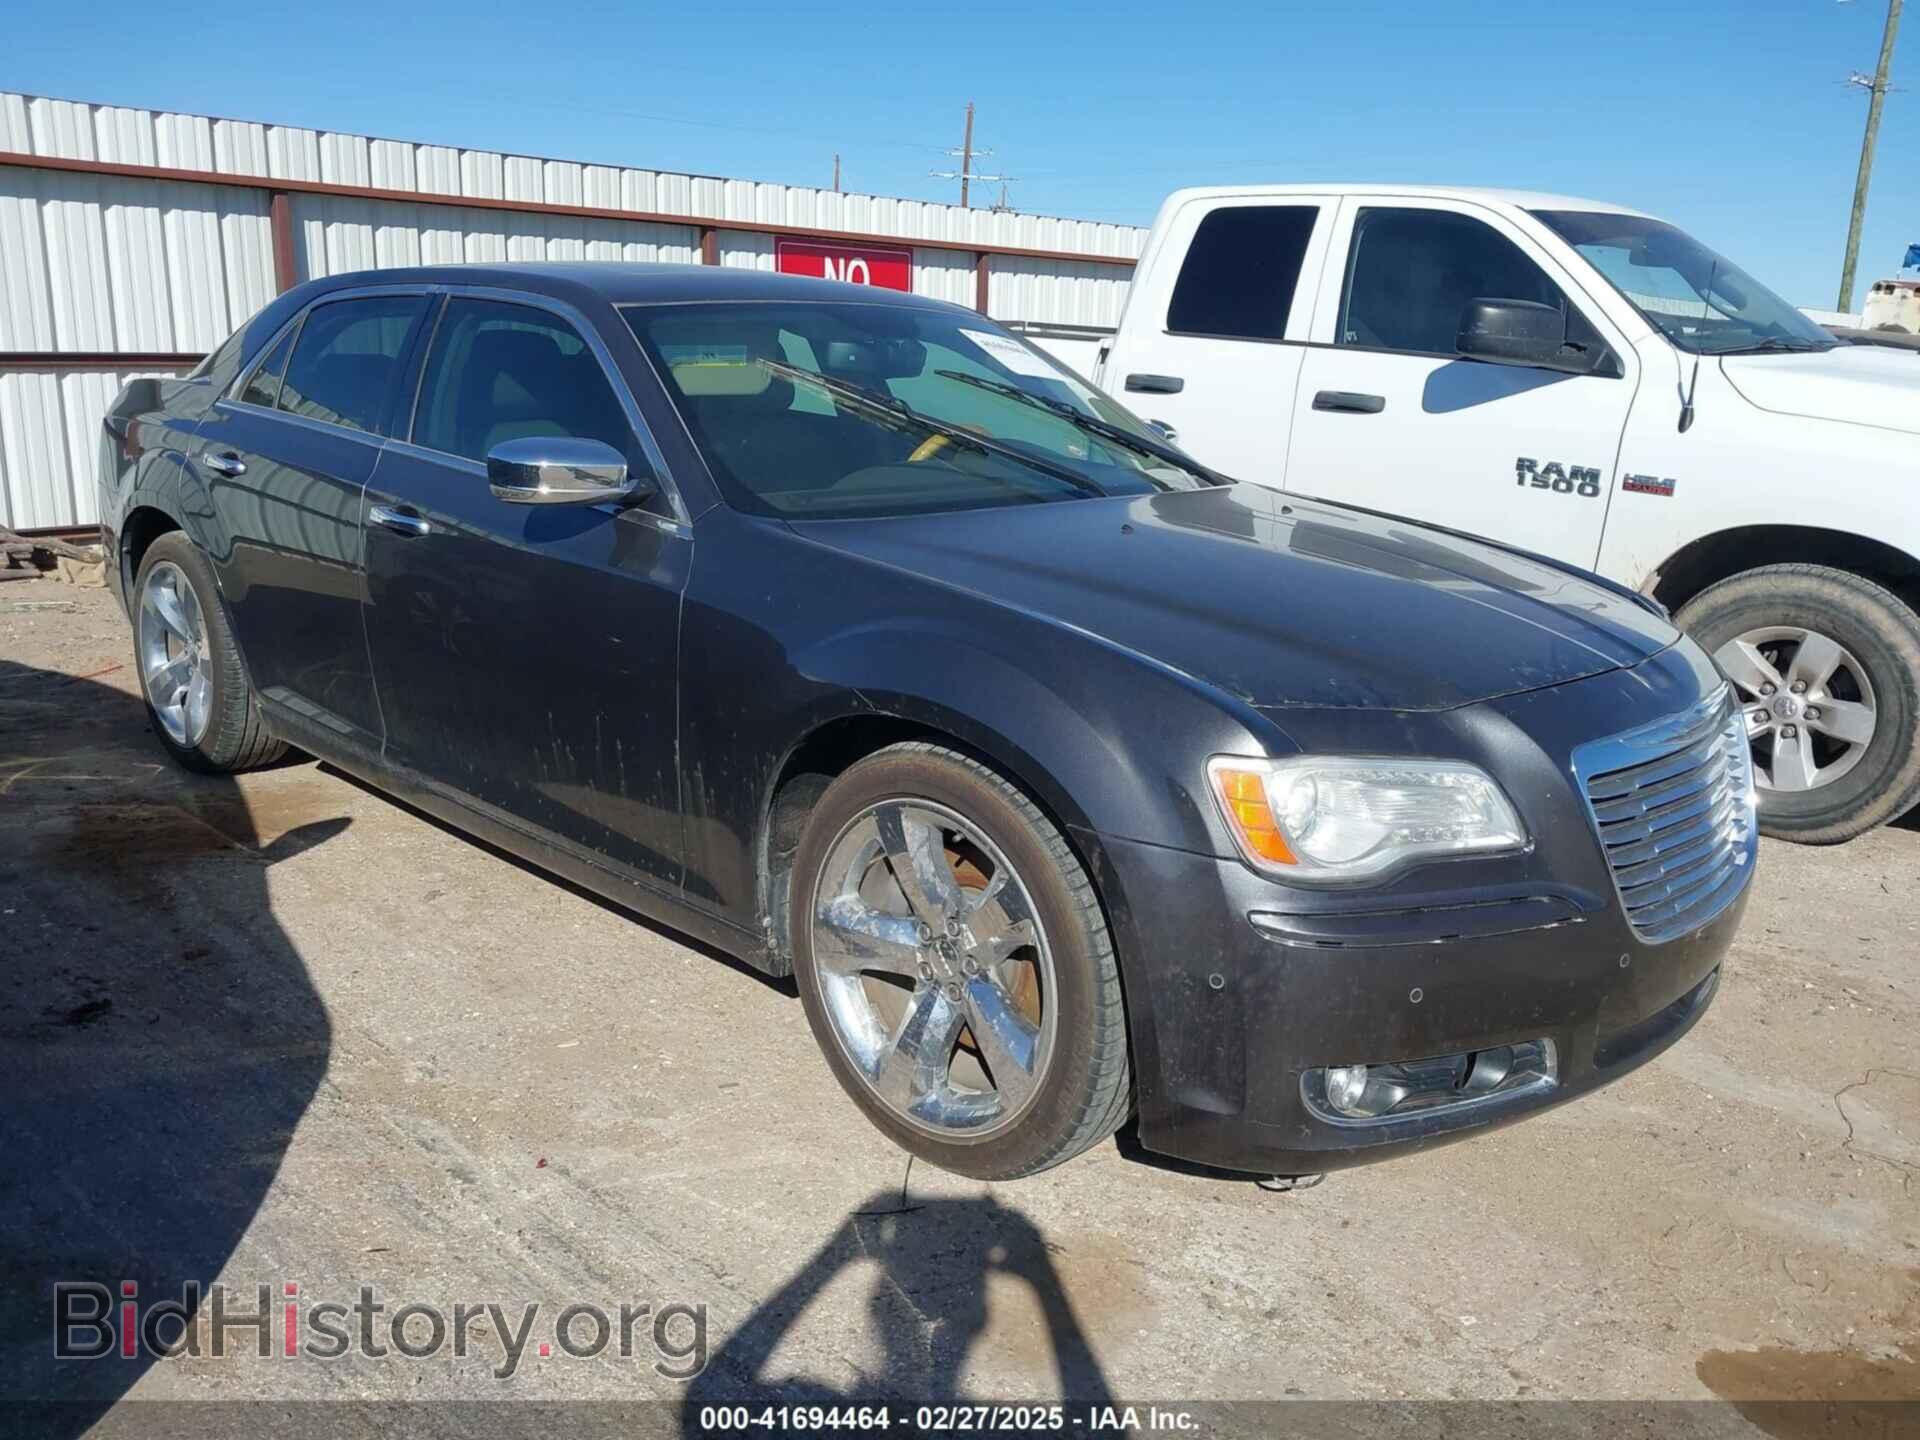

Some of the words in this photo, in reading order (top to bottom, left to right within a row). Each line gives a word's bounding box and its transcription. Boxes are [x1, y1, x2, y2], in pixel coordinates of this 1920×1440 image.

[824, 256, 871, 286] NO
[1516, 457, 1601, 484] RAM
[1516, 471, 1600, 498] 1500
